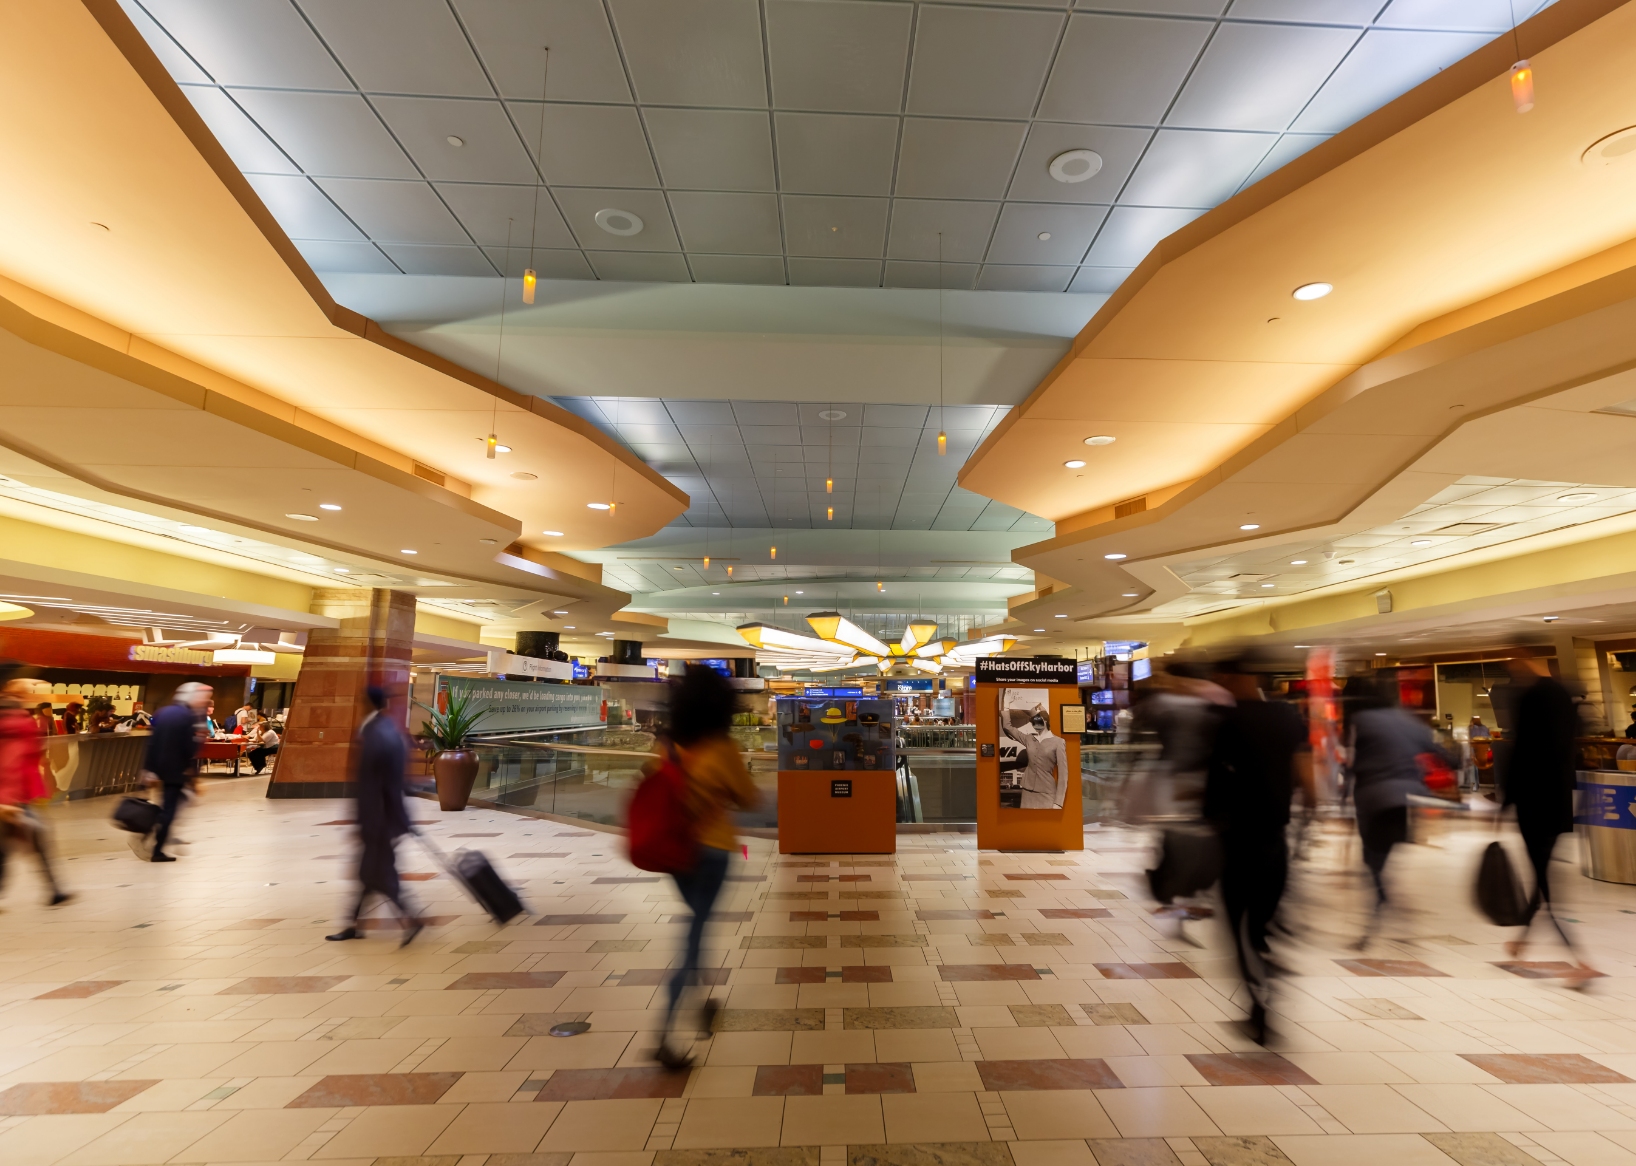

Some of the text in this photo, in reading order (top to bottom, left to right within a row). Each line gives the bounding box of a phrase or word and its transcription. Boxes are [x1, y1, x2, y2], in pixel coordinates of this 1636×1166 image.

[129, 645, 223, 666] smashburg
[979, 660, 1074, 674] #HatsOffSkyHarbor
[453, 685, 459, 698] If
[472, 687, 494, 702] parked
[494, 690, 504, 702] any
[505, 688, 521, 702] closer,
[522, 689, 533, 700] we'd
[534, 690, 539, 700] be
[540, 690, 555, 703] loading
[555, 694, 566, 703] cargo
[500, 706, 506, 715] up
[506, 705, 512, 713] to
[526, 706, 535, 715] your
[535, 704, 546, 714] airport
[547, 704, 558, 714] parking
